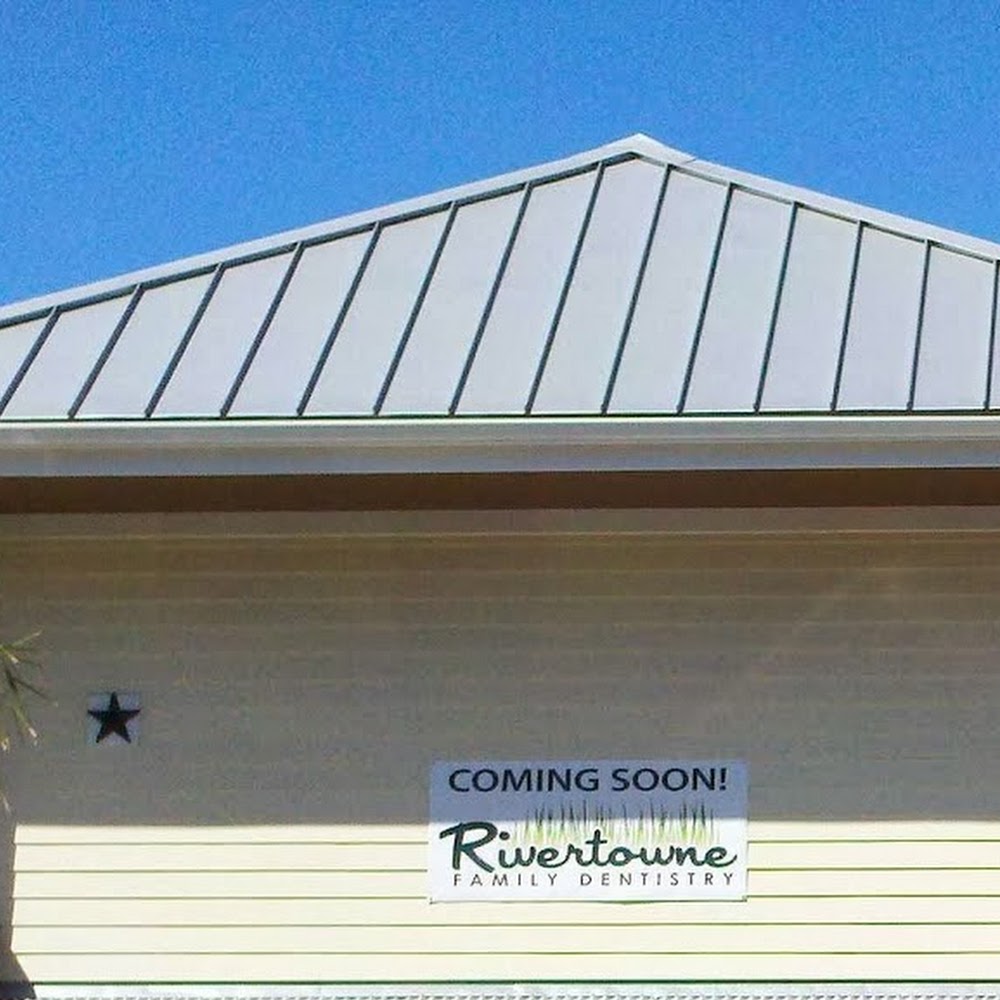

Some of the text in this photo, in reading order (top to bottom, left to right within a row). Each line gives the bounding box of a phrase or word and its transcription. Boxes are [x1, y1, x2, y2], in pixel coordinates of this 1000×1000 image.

[448, 767, 728, 793] COMING SOON!
[439, 821, 738, 873] Rivertowne
[453, 872, 735, 887] FAMILY DENTISTRY
